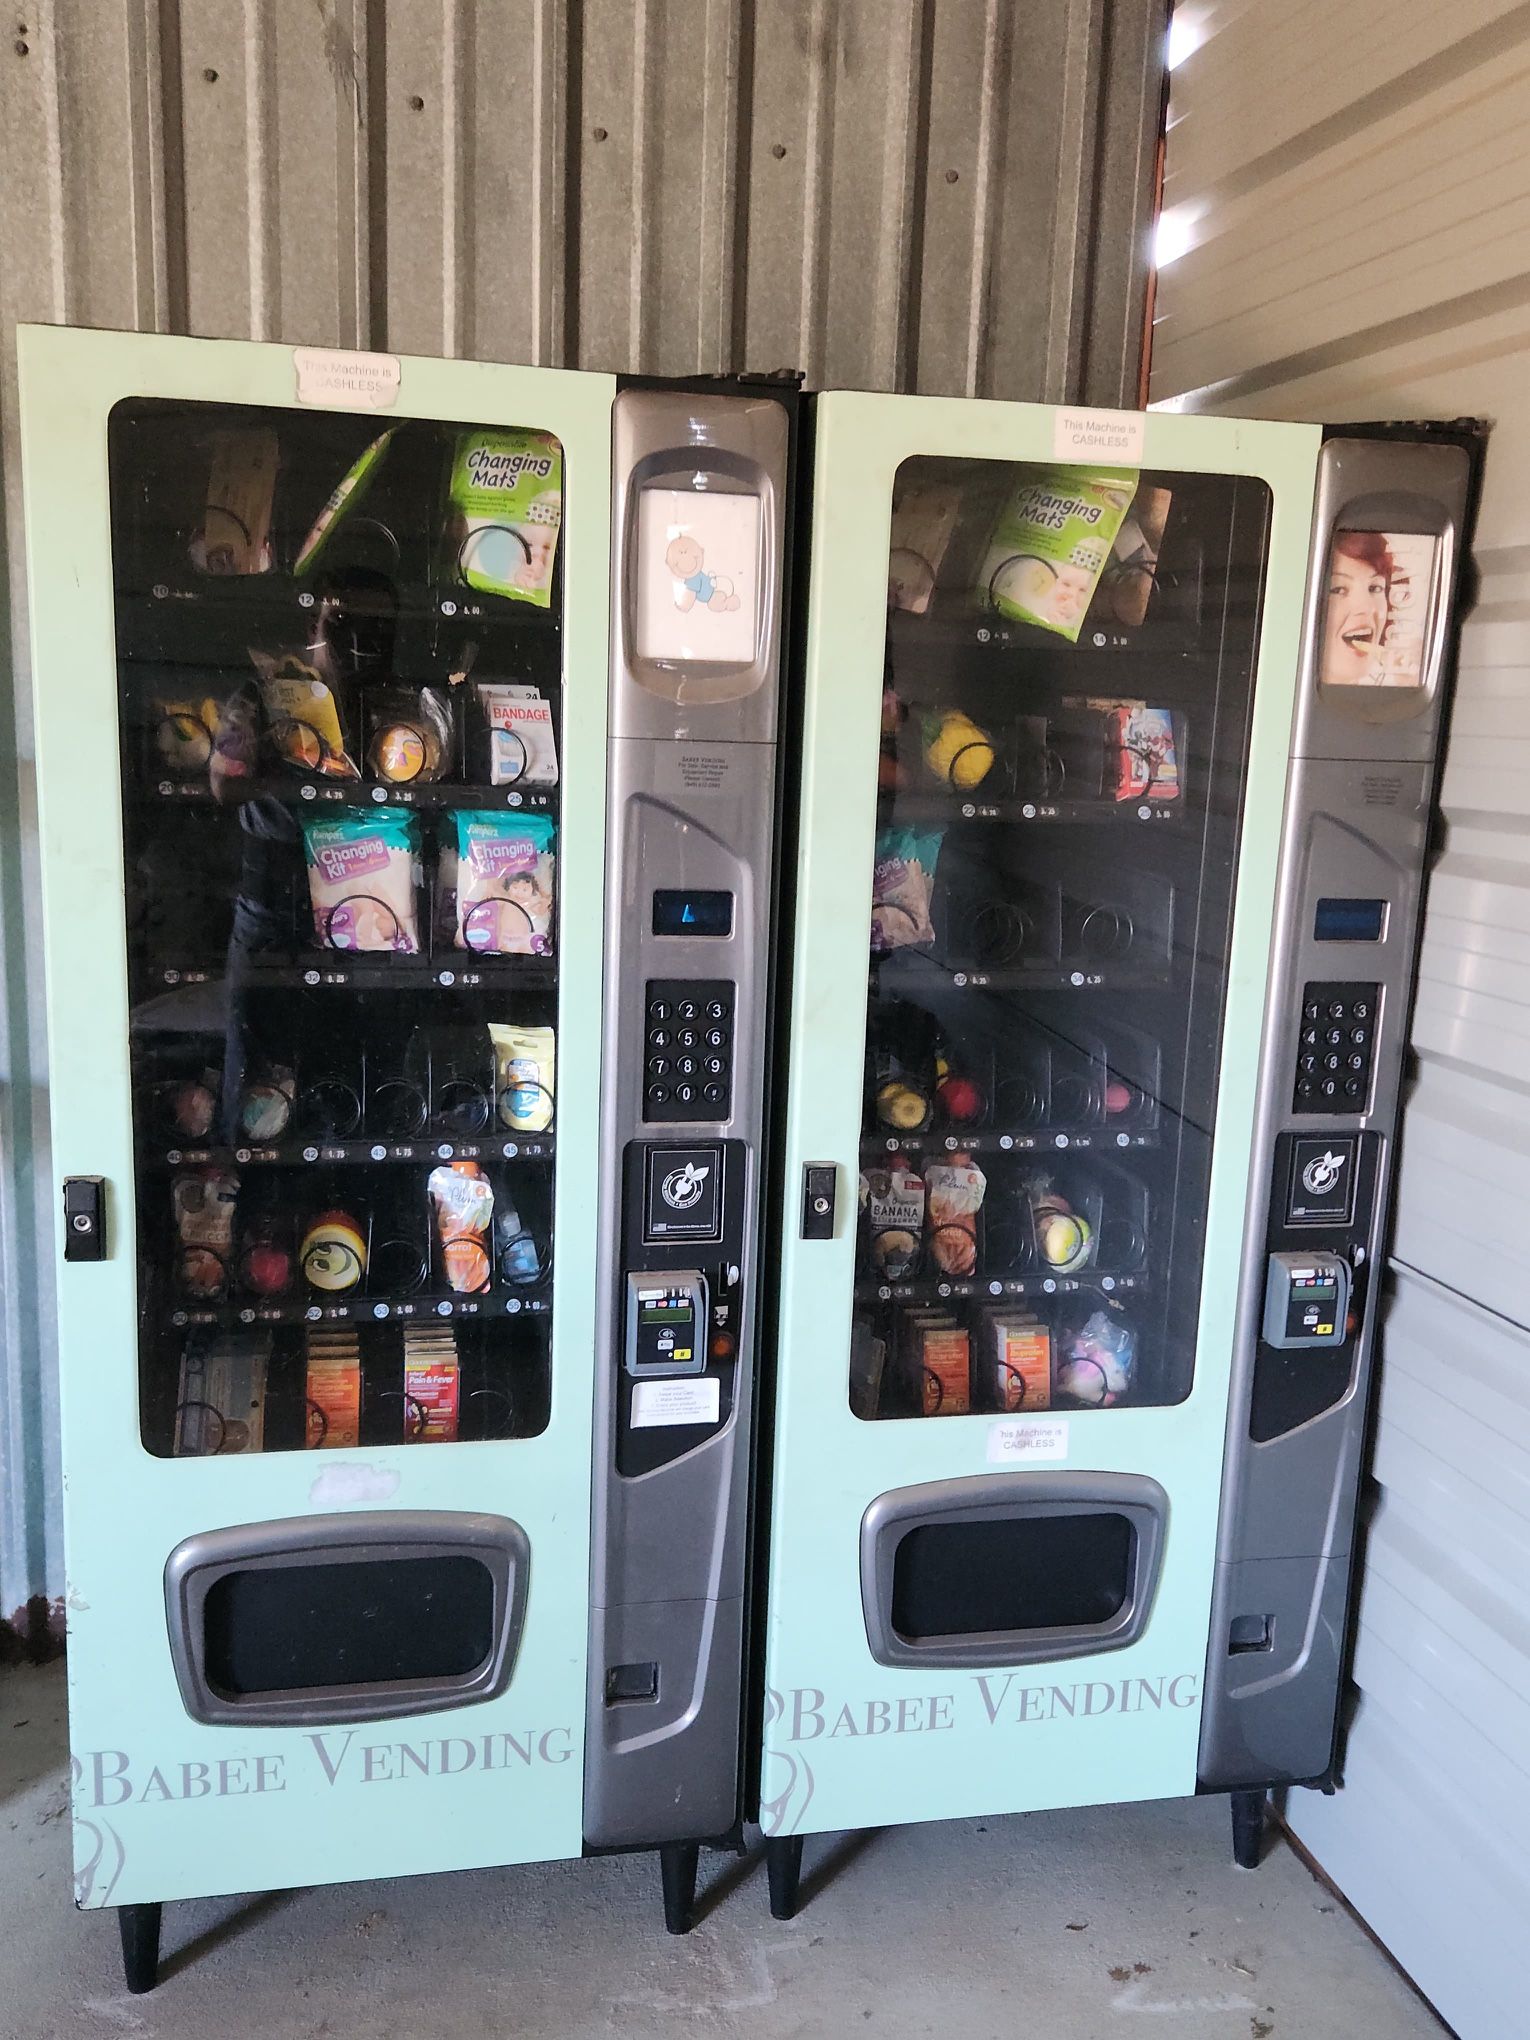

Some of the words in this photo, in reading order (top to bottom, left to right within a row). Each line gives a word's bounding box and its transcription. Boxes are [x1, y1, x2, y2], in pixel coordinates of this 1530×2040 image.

[331, 363, 379, 377] Machine
[382, 368, 392, 377] is
[1064, 420, 1084, 430] This
[1086, 421, 1126, 434] Machine
[1128, 424, 1137, 434] is
[1072, 434, 1129, 448] CASHLESS
[468, 450, 552, 476] Changing
[471, 470, 517, 488] Mats
[1018, 487, 1102, 523] Changing
[1018, 505, 1066, 529] Mats
[493, 707, 550, 721] BANDAGE
[320, 840, 384, 865] Changing
[473, 841, 534, 861] Changing
[326, 861, 347, 880] Kit
[478, 860, 496, 874] Kit
[399, 940, 406, 950] 4
[536, 941, 545, 952] 5
[657, 1005, 664, 1018] 1
[685, 1005, 694, 1018] 2
[713, 1004, 721, 1018] 3
[1311, 1005, 1318, 1018] 1
[1335, 1005, 1343, 1018] 2
[1358, 1004, 1367, 1018] 3
[655, 1032, 664, 1045] 4
[684, 1033, 693, 1046] 5
[711, 1032, 720, 1045] 6
[1307, 1030, 1316, 1044] 4
[1332, 1030, 1340, 1043] 5
[1355, 1030, 1364, 1043] 6
[656, 1060, 665, 1073] 7
[684, 1060, 692, 1073] 8
[711, 1060, 720, 1073] 9
[1306, 1056, 1314, 1069] 7
[1329, 1056, 1338, 1069] 8
[1353, 1056, 1361, 1069] 9
[682, 1087, 690, 1100] 0
[1326, 1081, 1335, 1094] 0
[874, 1205, 918, 1217] BANANA
[409, 1376, 425, 1385] Pain
[426, 1376, 434, 1384] &
[434, 1375, 455, 1384] Fever
[1016, 1428, 1052, 1438] Machine
[1003, 1439, 1056, 1449] CASHLESS
[787, 1688, 955, 1741] BABEE
[970, 1673, 1199, 1725] VENDING
[86, 1750, 287, 1807] BABEE
[302, 1727, 576, 1786] VENDING
